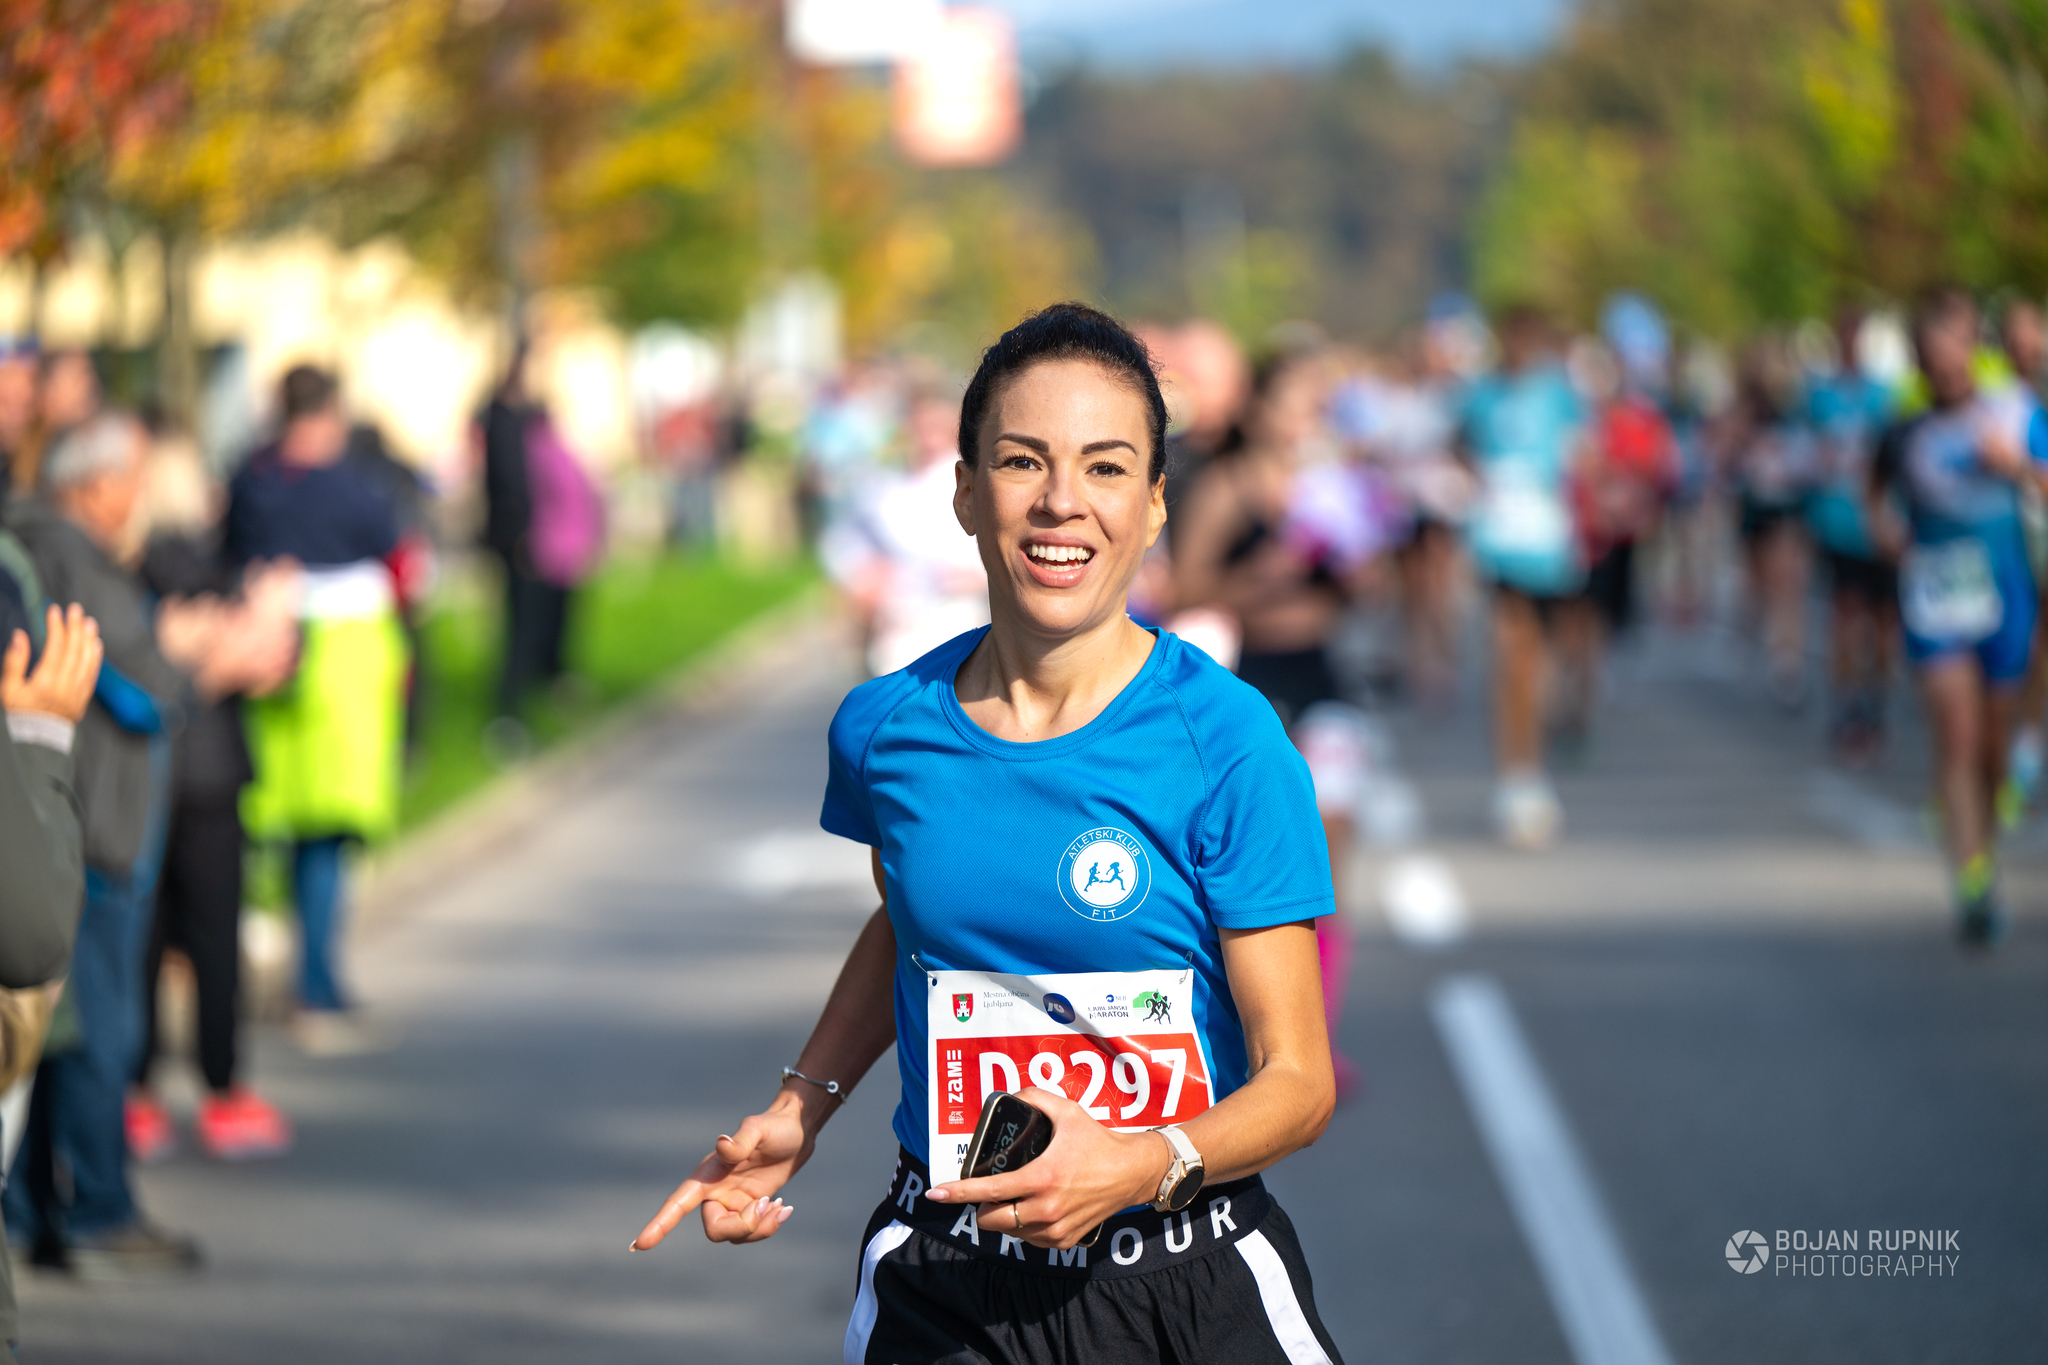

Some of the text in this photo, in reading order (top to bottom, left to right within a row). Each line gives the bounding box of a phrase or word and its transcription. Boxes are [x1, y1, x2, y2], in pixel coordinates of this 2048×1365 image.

[1068, 830, 1141, 859] ATLETSKI KLUB
[1092, 908, 1116, 919] FIT
[983, 1001, 1014, 1009] Ljubljana
[1089, 1011, 1129, 1019] MARATON
[979, 1048, 1187, 1121] D8297
[991, 1121, 1019, 1176] 10:34
